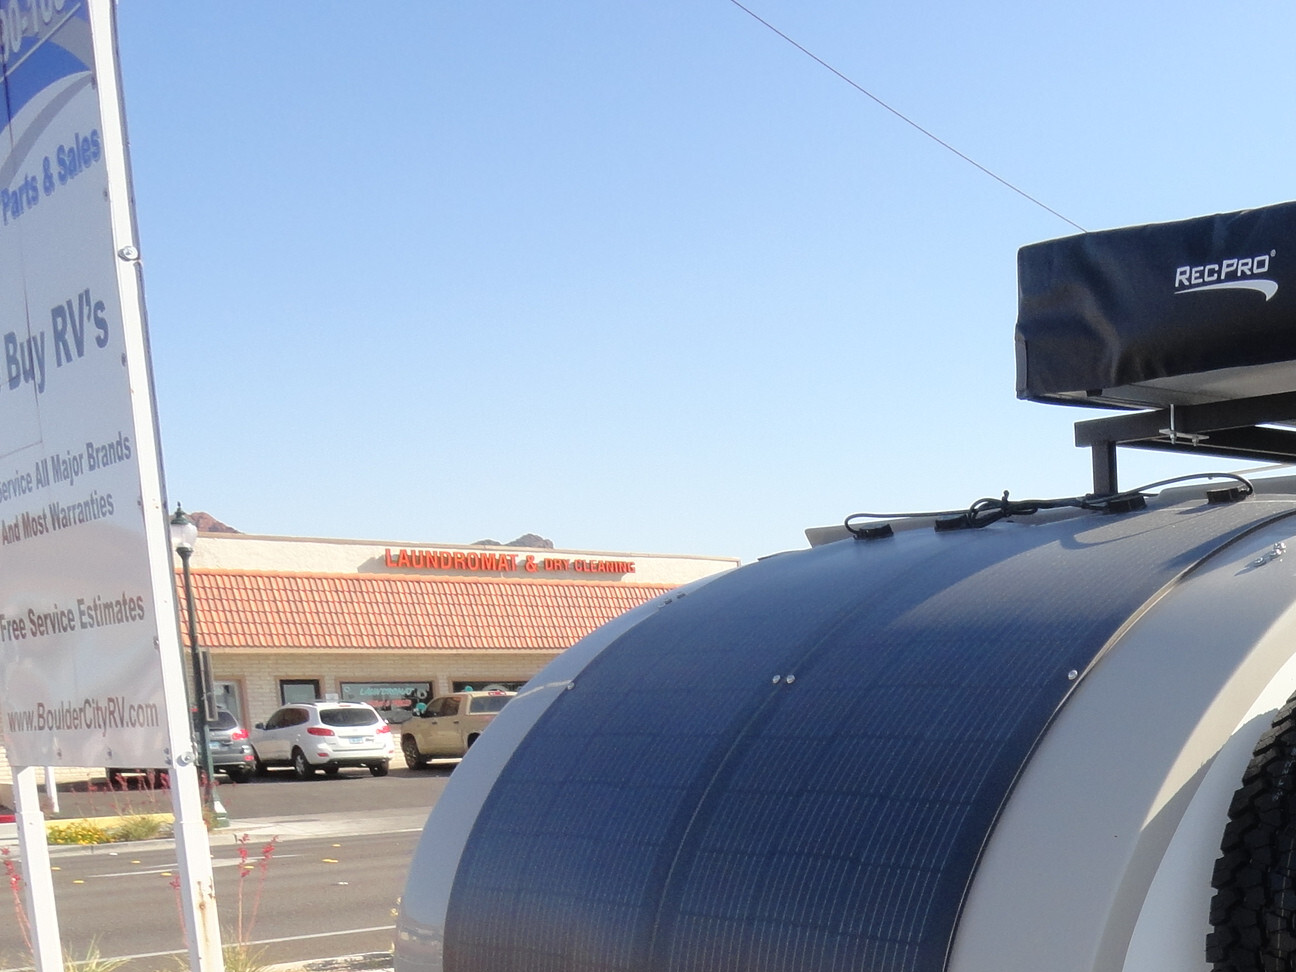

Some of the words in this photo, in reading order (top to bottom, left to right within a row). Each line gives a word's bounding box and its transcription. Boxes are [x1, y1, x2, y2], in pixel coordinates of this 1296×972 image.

[1, 173, 39, 226] Parts
[43, 155, 55, 197] &
[57, 129, 101, 186] Sales
[4, 331, 45, 394] Buy
[51, 288, 109, 368] RV's
[0, 469, 33, 503] ervice
[35, 458, 50, 490] All
[51, 450, 84, 486] Major
[86, 431, 131, 472] Brands
[2, 519, 21, 546] And
[22, 506, 49, 539] Most
[49, 490, 114, 531] Warranties
[385, 549, 518, 572] LAUNDROMAT
[525, 555, 539, 573] &
[544, 558, 569, 572] DRY
[574, 559, 636, 574] CLEANING
[0, 613, 27, 642] Free
[28, 603, 76, 638] Service
[77, 592, 145, 629] Estimates
[7, 696, 159, 737] www.BoulderCityRV.com
